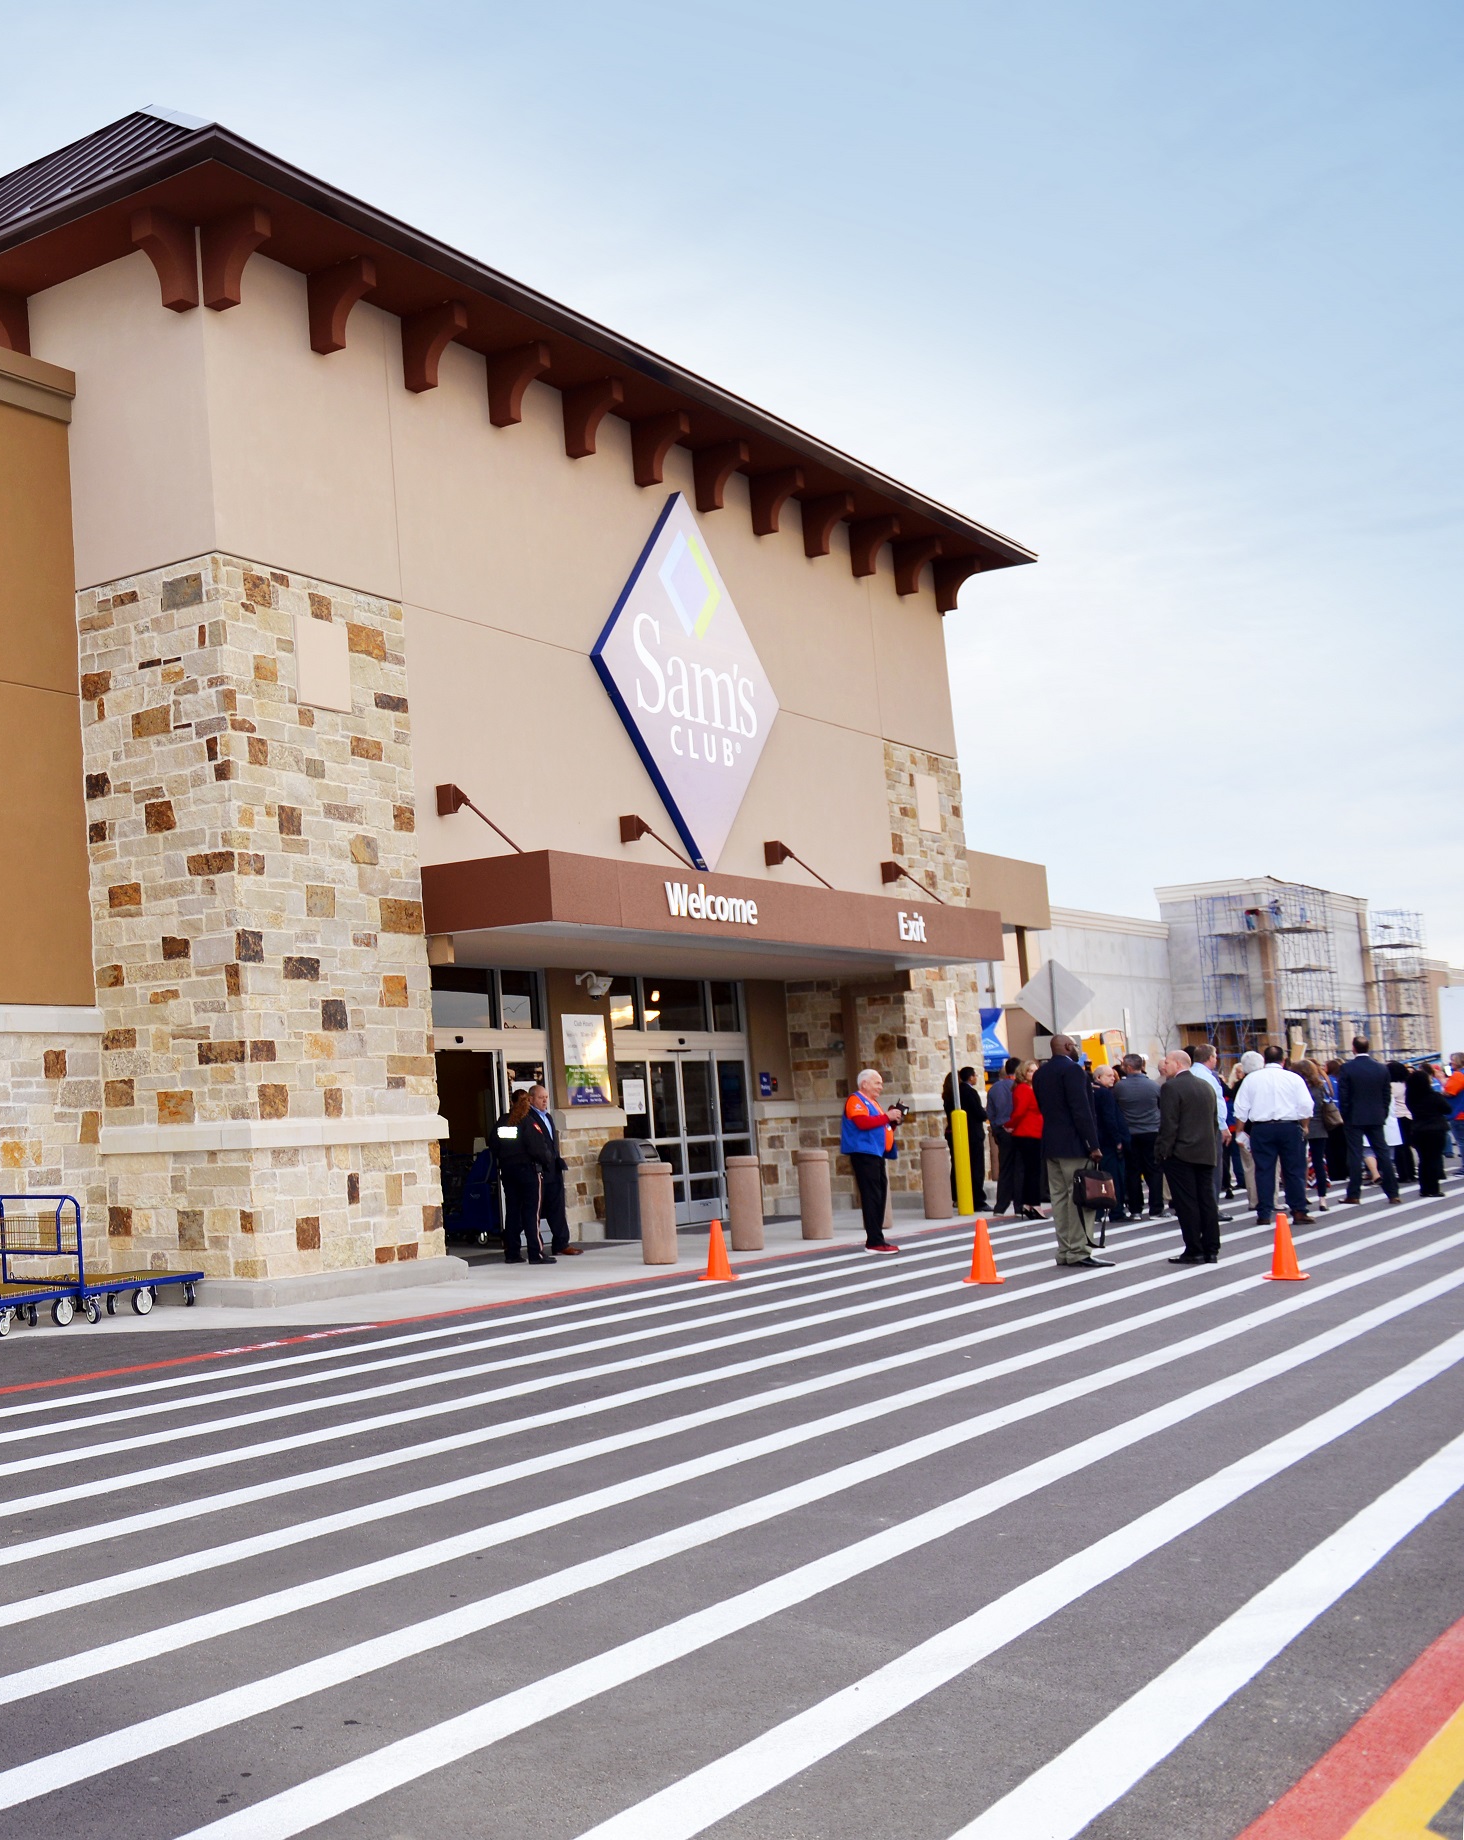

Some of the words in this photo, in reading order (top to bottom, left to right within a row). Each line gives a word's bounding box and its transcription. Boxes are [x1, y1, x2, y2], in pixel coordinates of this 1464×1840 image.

[633, 612, 758, 739] Sam's
[670, 725, 734, 767] CLUB
[664, 881, 758, 925] Welcome
[897, 911, 927, 943] Exit
